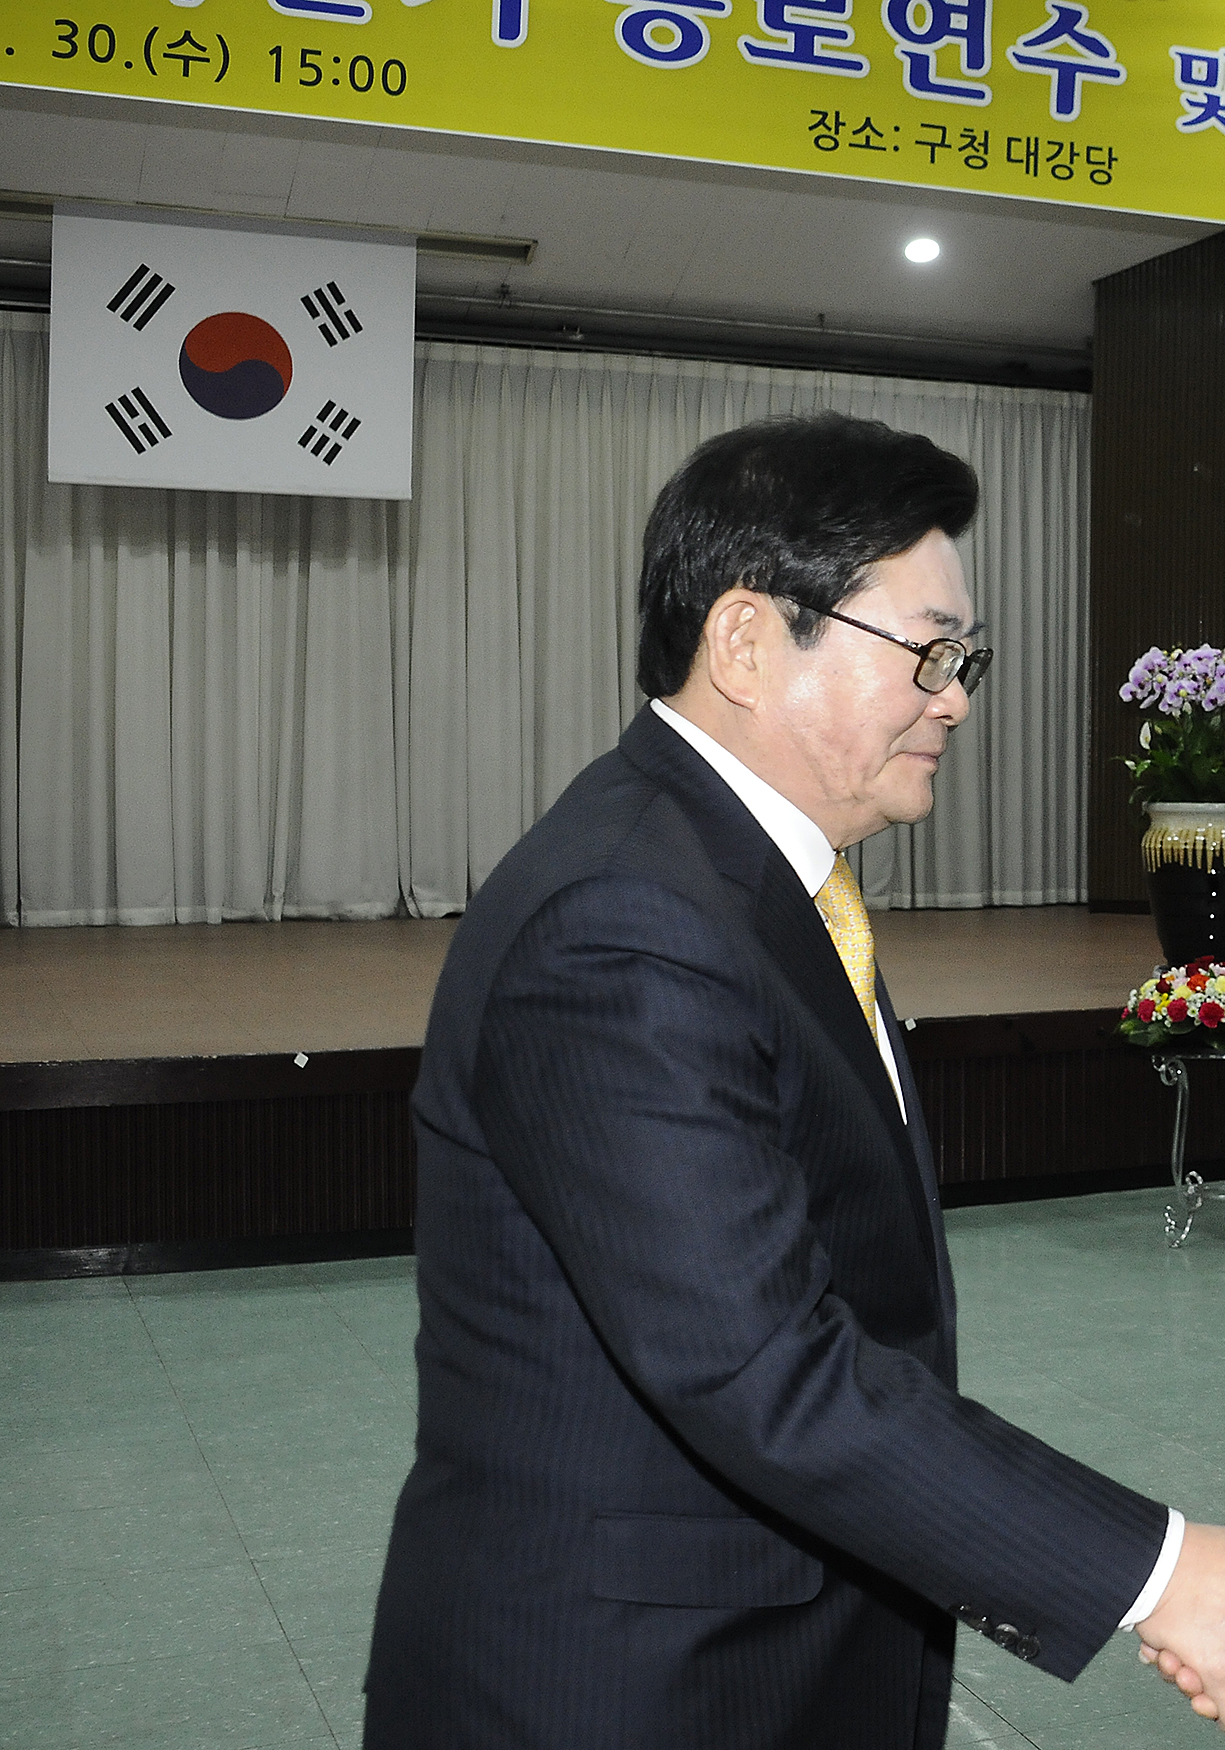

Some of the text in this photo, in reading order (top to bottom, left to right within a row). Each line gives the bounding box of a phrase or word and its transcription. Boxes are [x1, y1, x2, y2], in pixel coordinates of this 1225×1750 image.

[51, 18, 231, 83] 30.(수)
[267, 45, 408, 97] 15:00
[808, 109, 1119, 186] 장소: 구청 대강당
